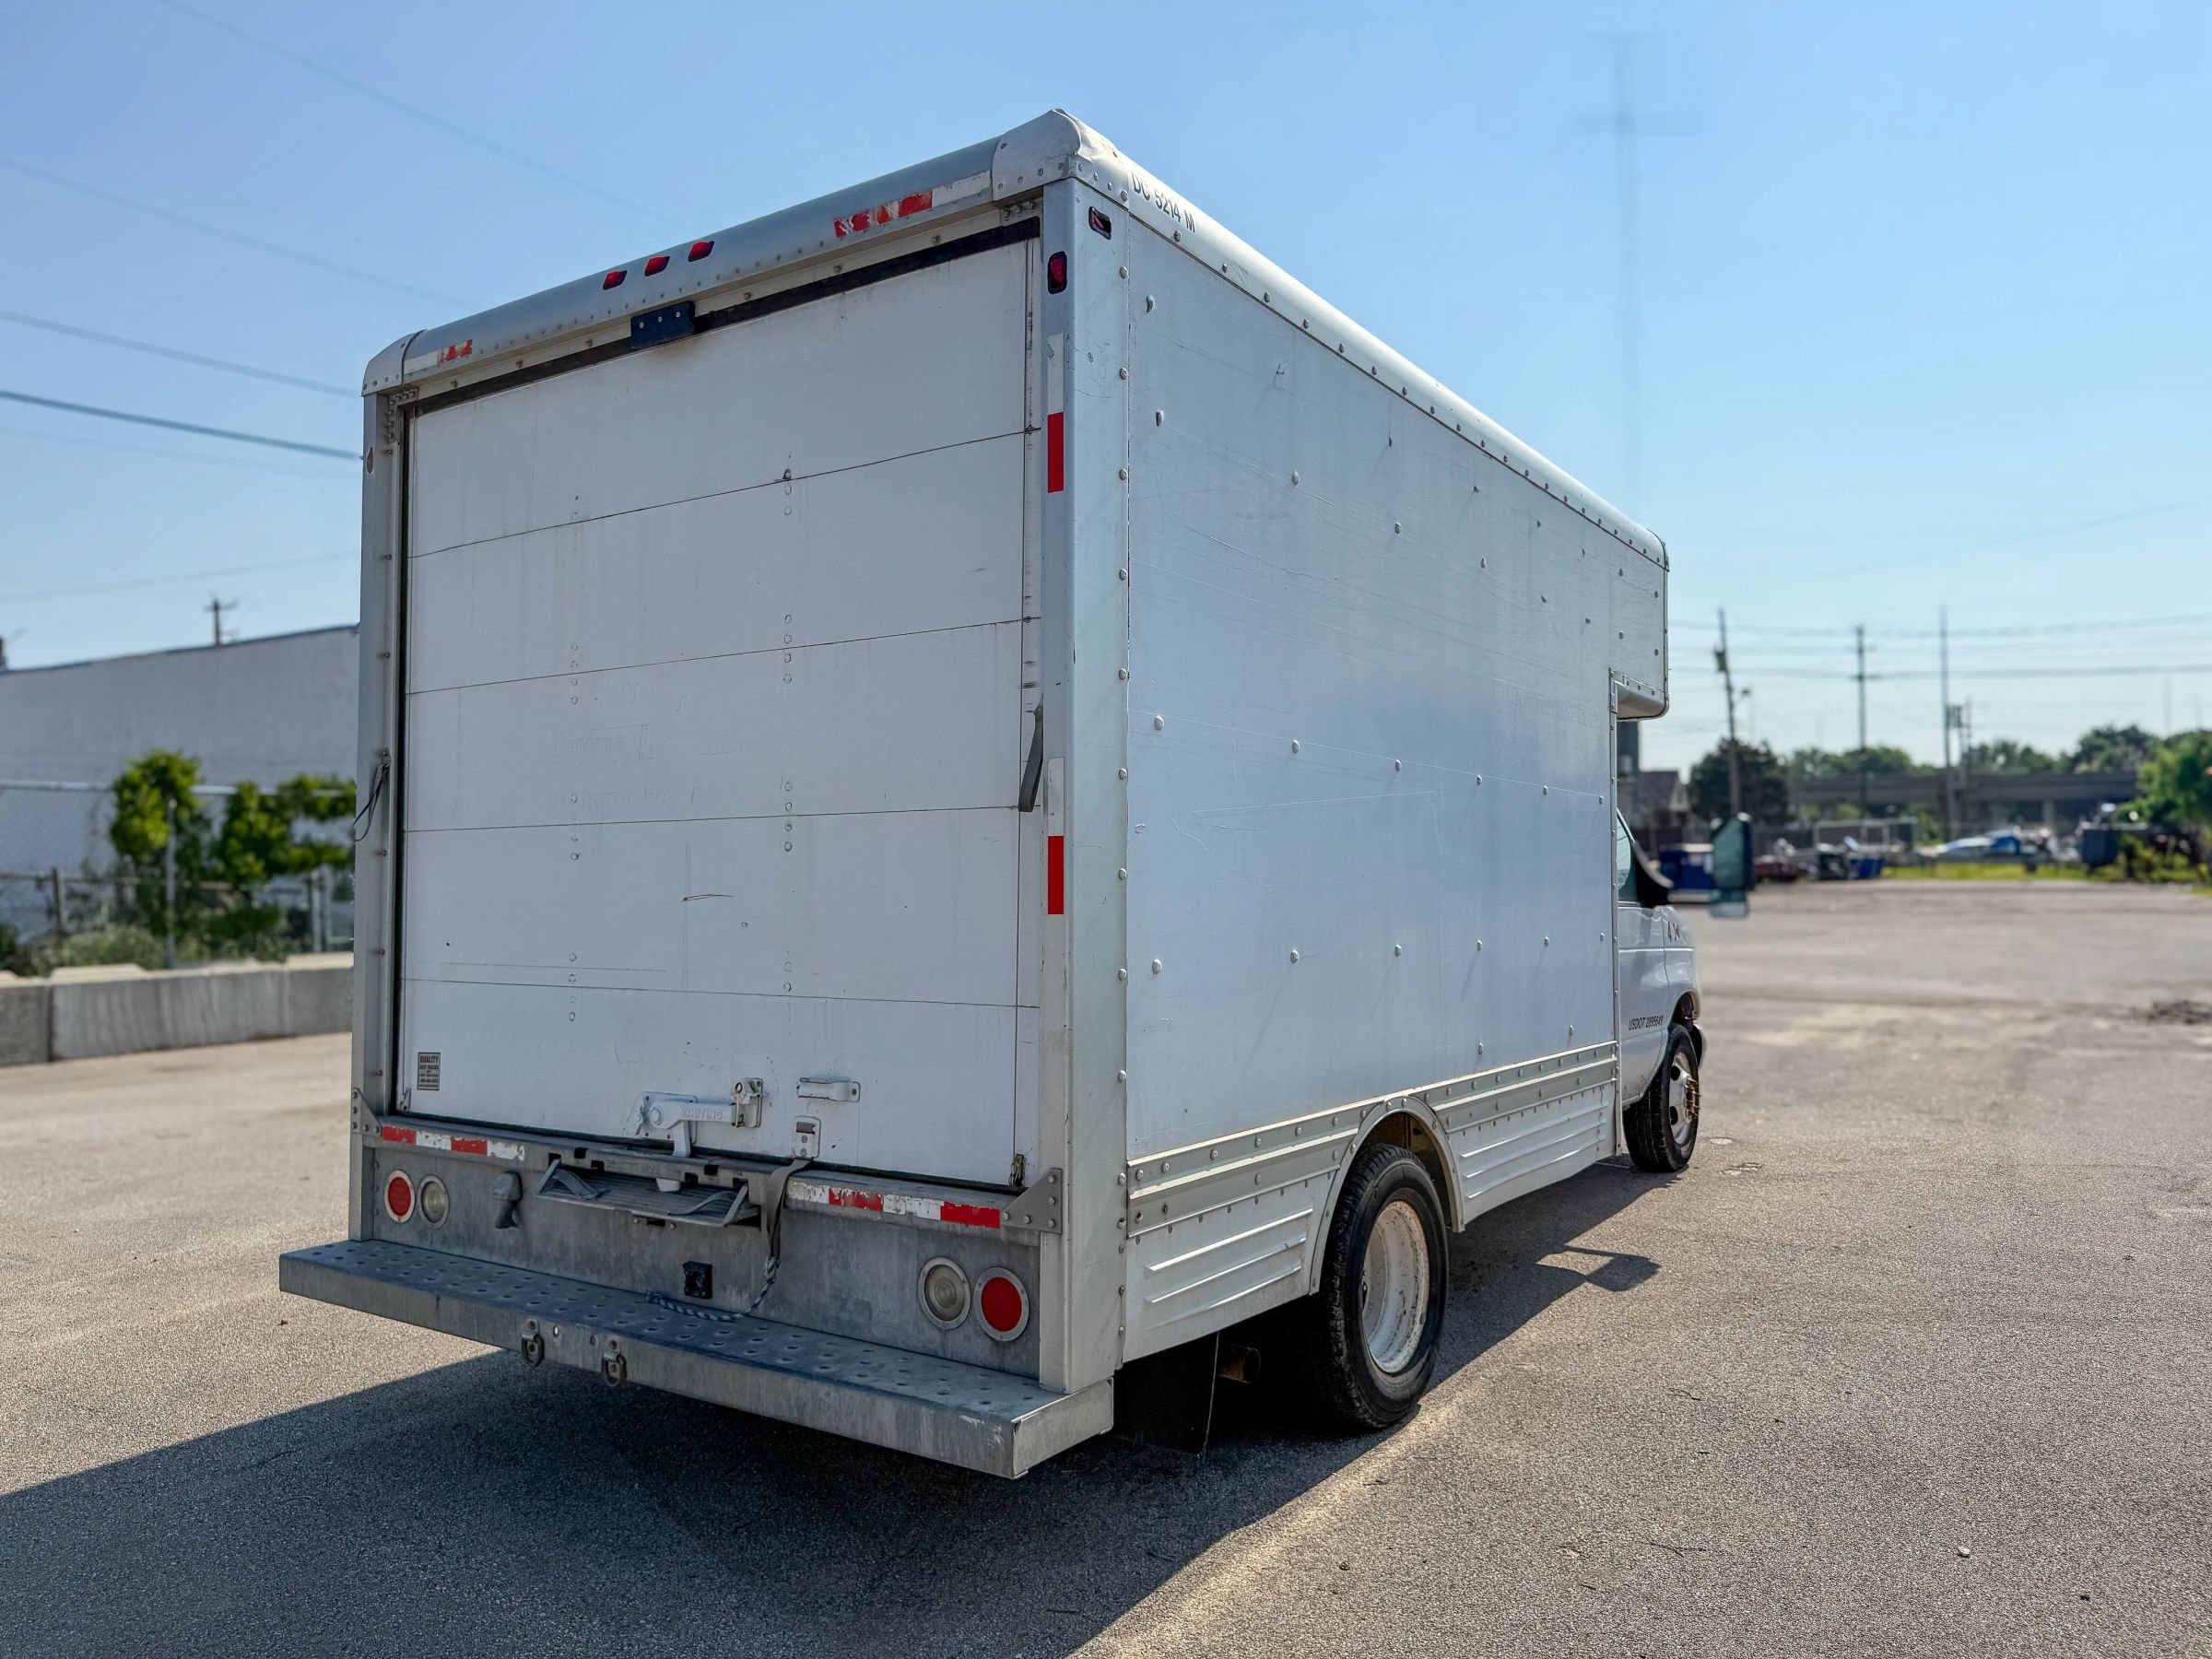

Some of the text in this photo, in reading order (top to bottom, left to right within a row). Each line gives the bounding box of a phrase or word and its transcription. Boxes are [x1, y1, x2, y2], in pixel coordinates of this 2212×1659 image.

[1155, 189, 1181, 223] 5214
[1183, 209, 1195, 233] M
[1629, 1017, 1645, 1030] USDOT
